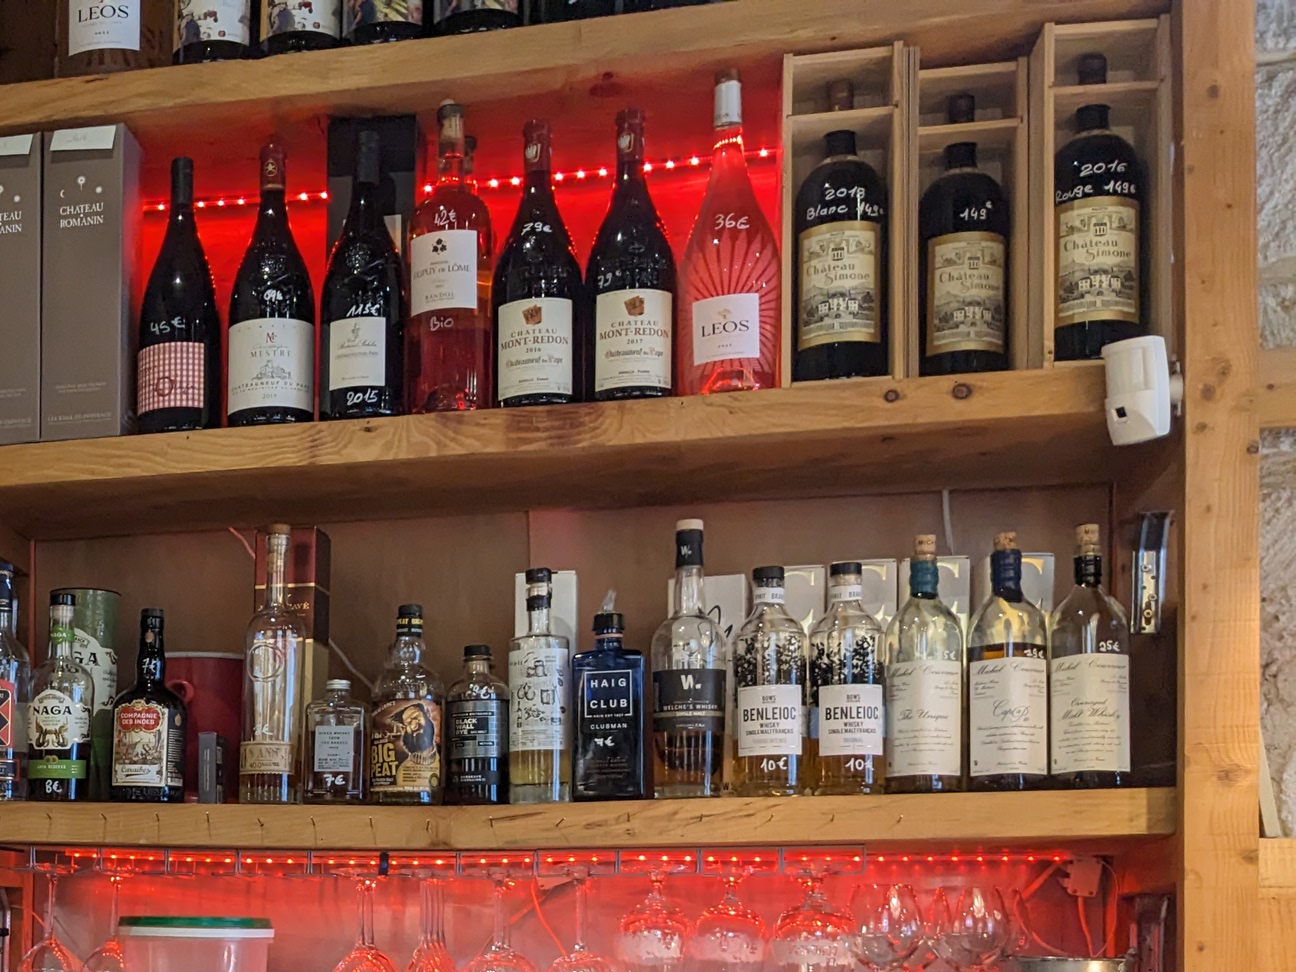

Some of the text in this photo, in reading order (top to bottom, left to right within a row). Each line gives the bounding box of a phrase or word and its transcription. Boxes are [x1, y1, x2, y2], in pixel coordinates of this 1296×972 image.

[78, 5, 129, 23] LEOS
[1079, 159, 1127, 177] 2016
[825, 187, 866, 201] 2018
[59, 202, 104, 215] CHATEAU
[806, 203, 849, 220] Blanc
[959, 201, 992, 220] 149€
[59, 215, 104, 228] ROMANIN
[714, 214, 750, 230] 36€
[1063, 237, 1118, 252] Château
[1085, 248, 1131, 262] Simone
[806, 260, 855, 276] Château
[824, 270, 870, 286] Simone
[939, 270, 990, 283] Château
[961, 279, 1000, 294] Simone
[346, 303, 383, 317] 115€
[150, 318, 185, 335] 45€
[611, 318, 658, 329] CHATEAU
[701, 319, 750, 337] LEOS
[510, 327, 557, 337] CHATEAU
[599, 327, 669, 341] MONT-REDON
[500, 336, 568, 351] MONT-REDON
[346, 388, 378, 404] 2015
[590, 678, 627, 688] HAIG
[33, 705, 72, 716] NAGA
[590, 698, 628, 709] CLUB
[120, 712, 157, 721] COMPAGNIE
[743, 706, 796, 722] BENLEIOC
[825, 706, 879, 720] BENLEIOC
[372, 743, 395, 763] BIG
[371, 761, 399, 778] PEAT
[760, 757, 787, 772] 10€
[45, 779, 62, 793] 8€
[323, 774, 345, 787] 7€
